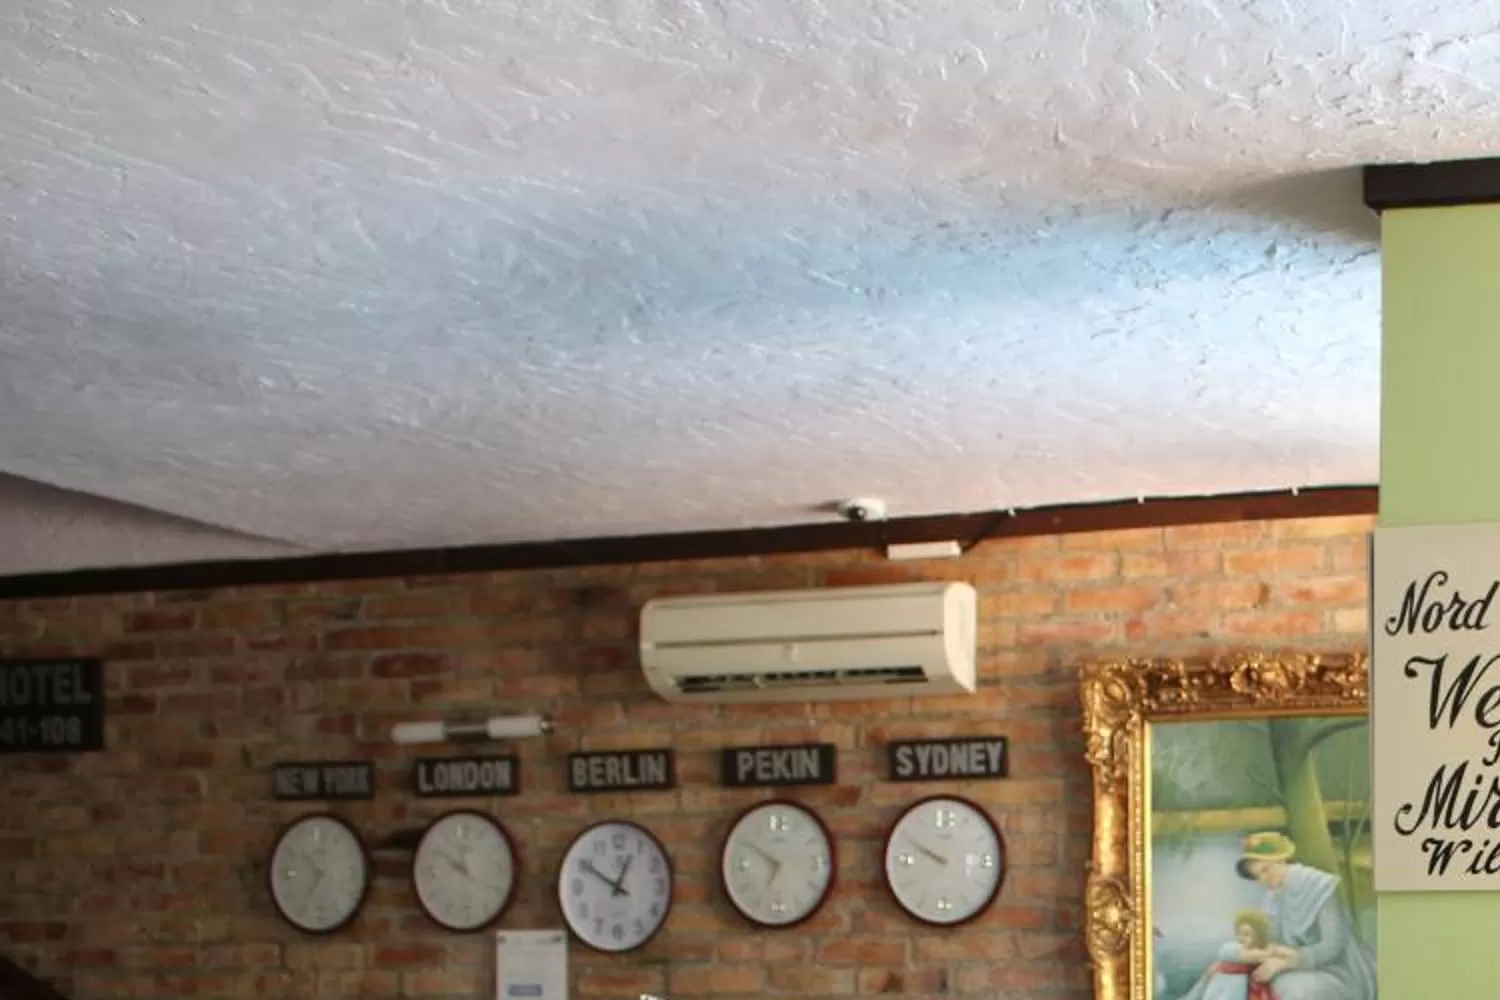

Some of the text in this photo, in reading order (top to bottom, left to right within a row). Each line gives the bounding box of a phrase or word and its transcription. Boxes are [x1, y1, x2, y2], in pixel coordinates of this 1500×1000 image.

[1385, 571, 1500, 636] Nord
[572, 752, 666, 787] BERLIN
[735, 748, 820, 782] PEKIN
[895, 740, 1003, 775] SYDNEY
[275, 764, 370, 795] NEW YORK
[417, 759, 511, 792] LONDON
